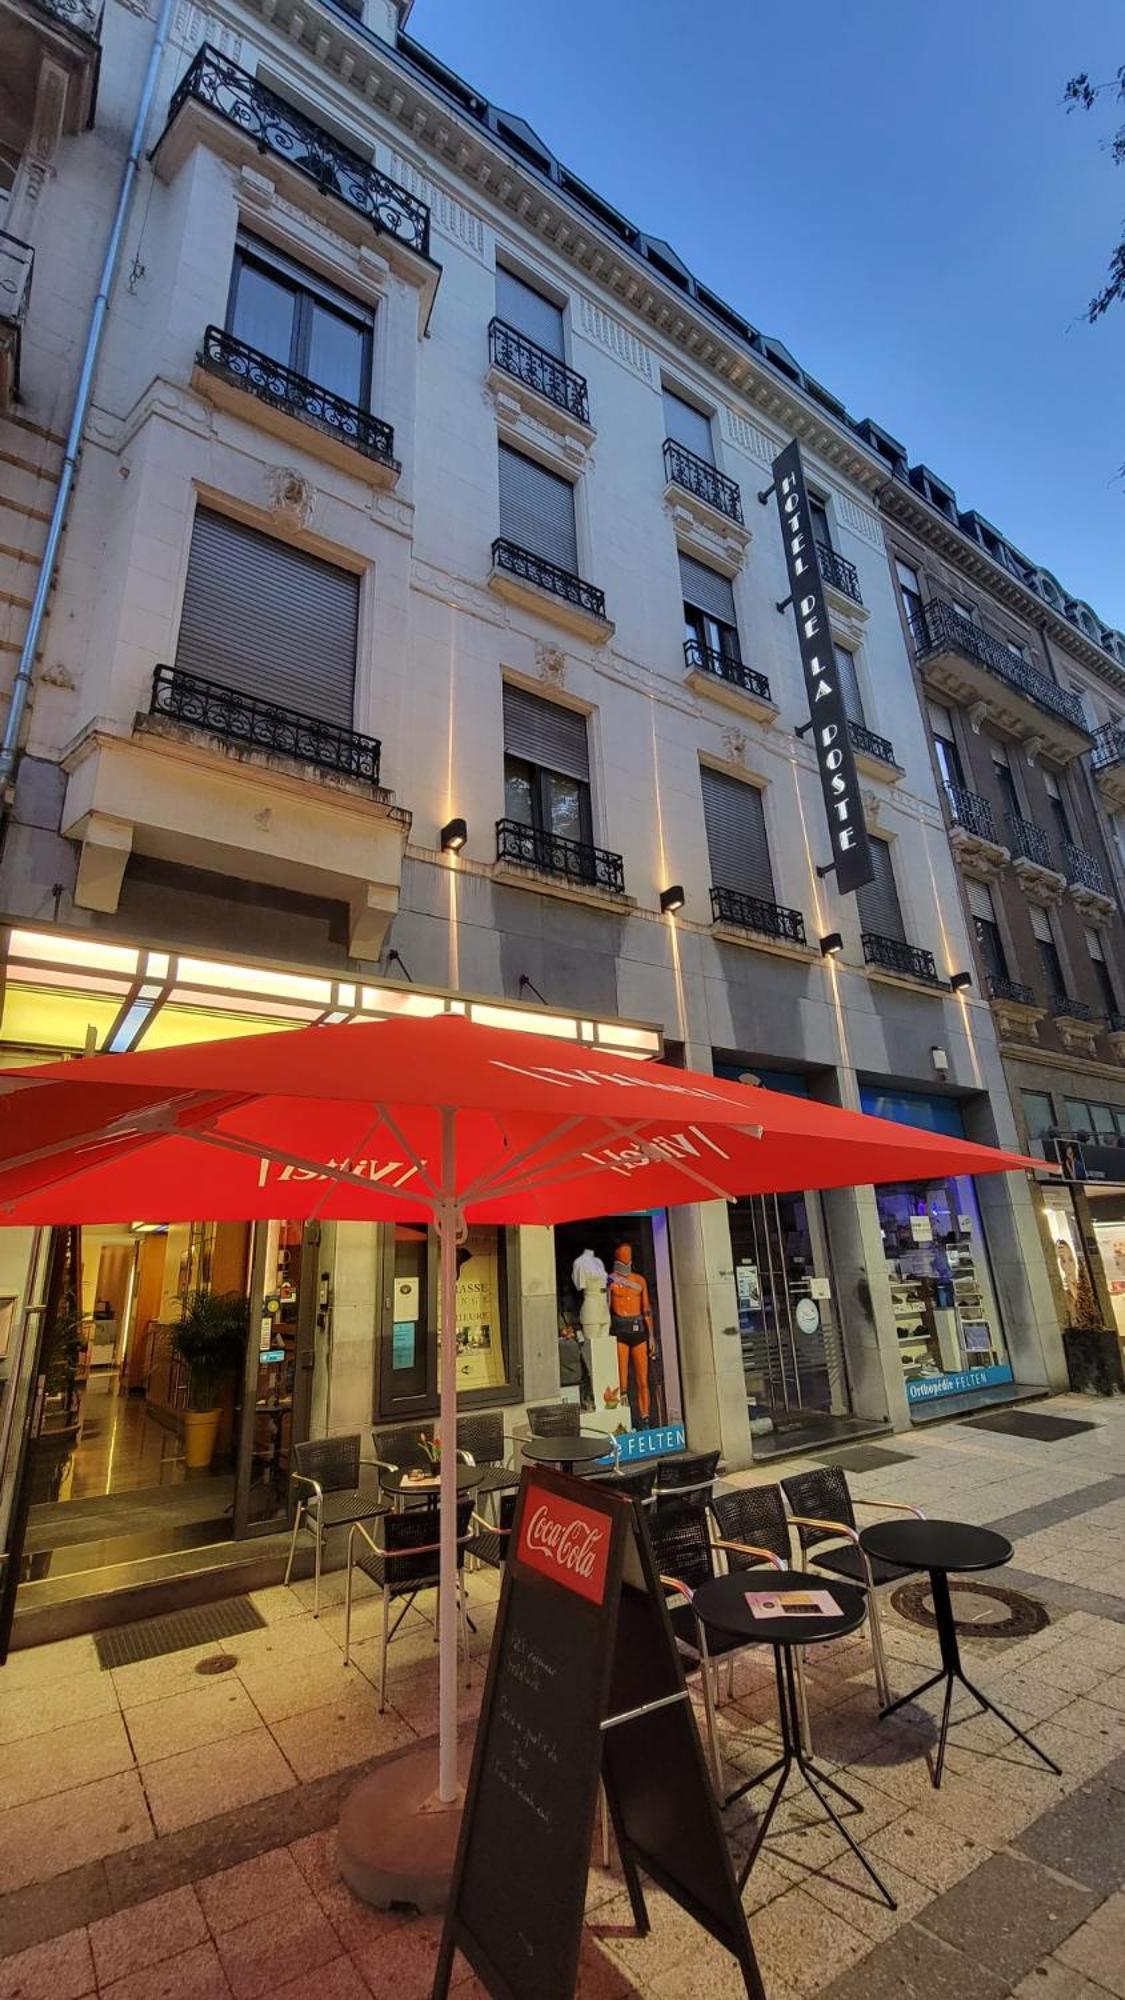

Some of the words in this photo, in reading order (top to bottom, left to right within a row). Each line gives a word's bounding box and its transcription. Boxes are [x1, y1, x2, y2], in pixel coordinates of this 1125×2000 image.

[782, 471, 809, 577] HOTEL
[801, 595, 820, 639] DE
[811, 656, 833, 702] LA
[822, 724, 857, 851] POSTE
[957, 1372, 988, 1389] FELTEN
[628, 1429, 686, 1456] FELTEN
